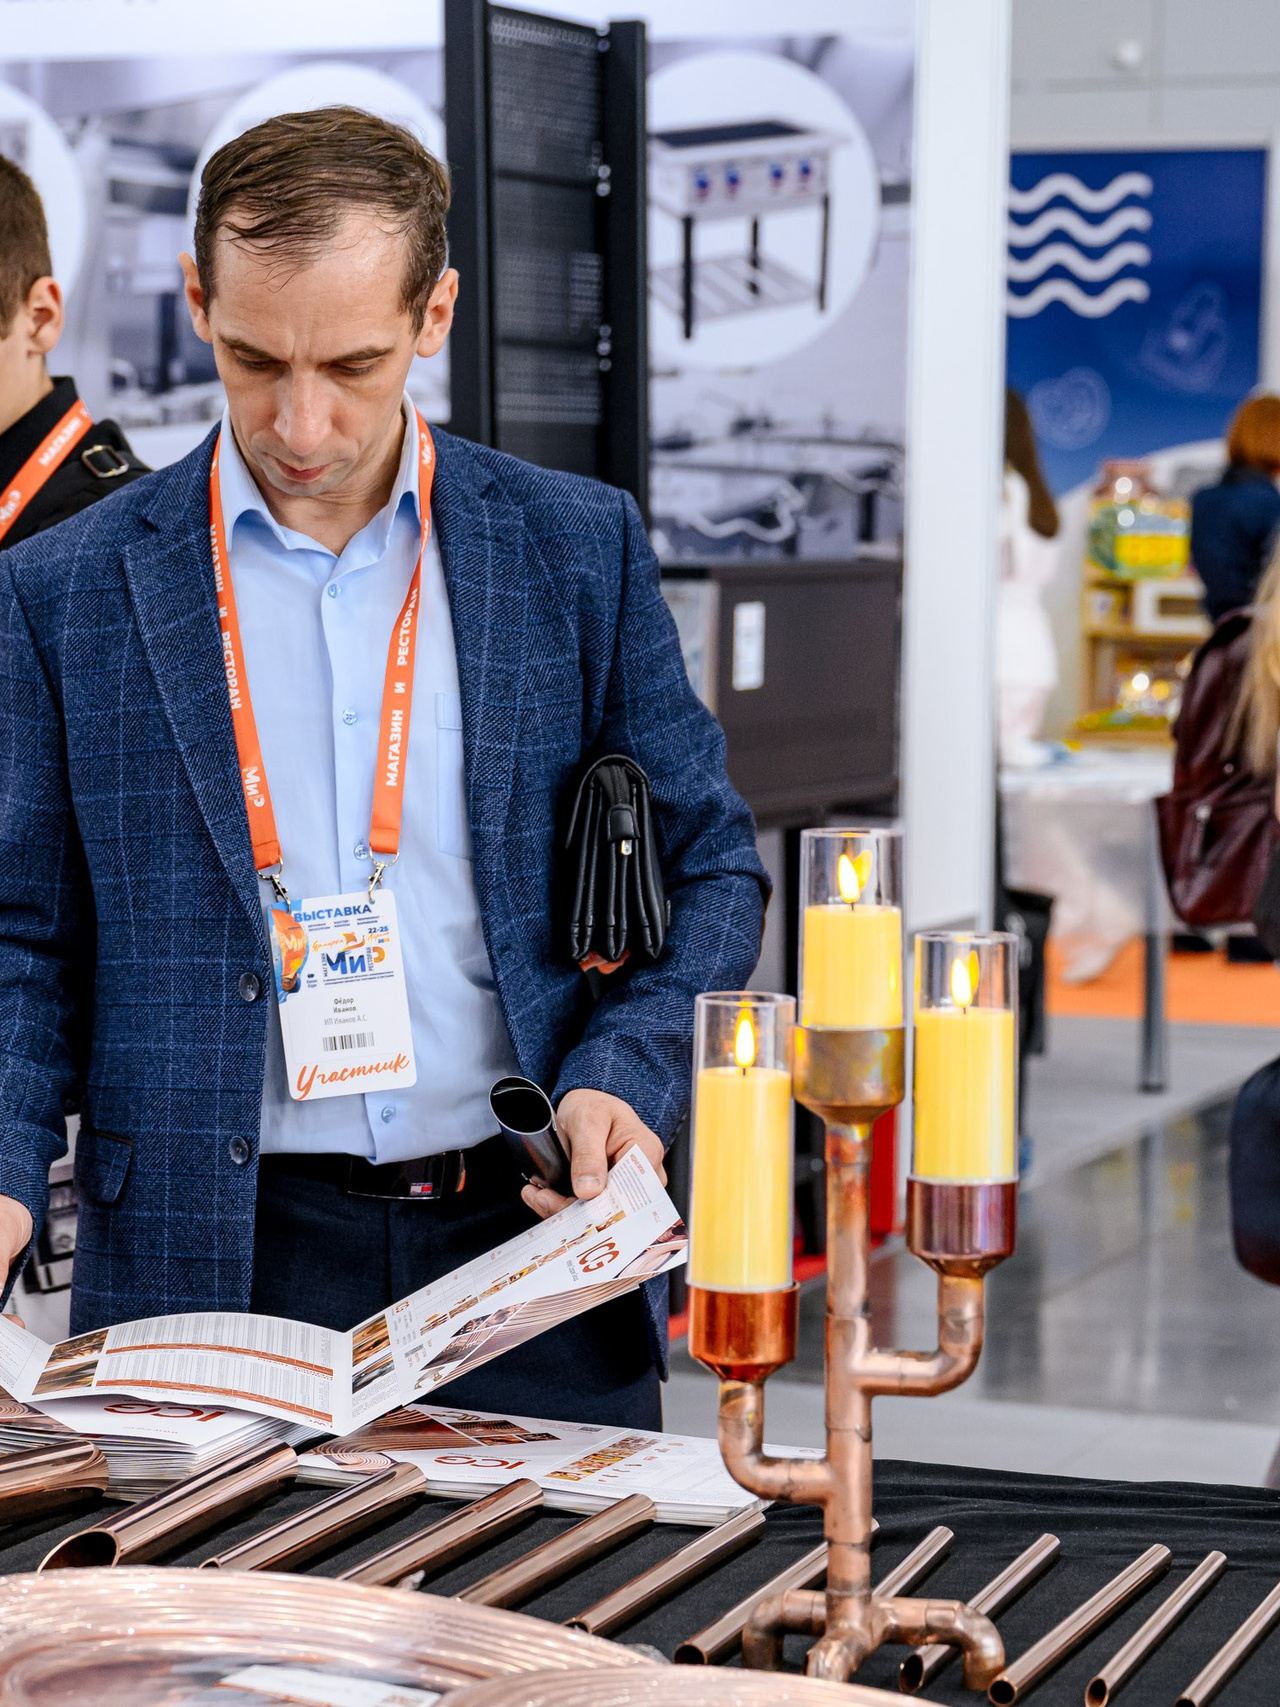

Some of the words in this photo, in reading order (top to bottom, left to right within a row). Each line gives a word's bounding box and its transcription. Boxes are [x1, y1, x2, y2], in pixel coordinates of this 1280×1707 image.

[396, 587, 419, 667] РЕСТОРАН
[220, 630, 242, 710] РЕСТОРАН
[393, 681, 406, 694] И
[386, 709, 404, 787] МАГАЗИН
[293, 904, 372, 923] ВЫСТАВКА
[368, 925, 389, 934] 22-25
[296, 1052, 411, 1101] Участник
[576, 1236, 620, 1273] ICG
[103, 1402, 228, 1423] ICG
[433, 1455, 527, 1470] ICG
